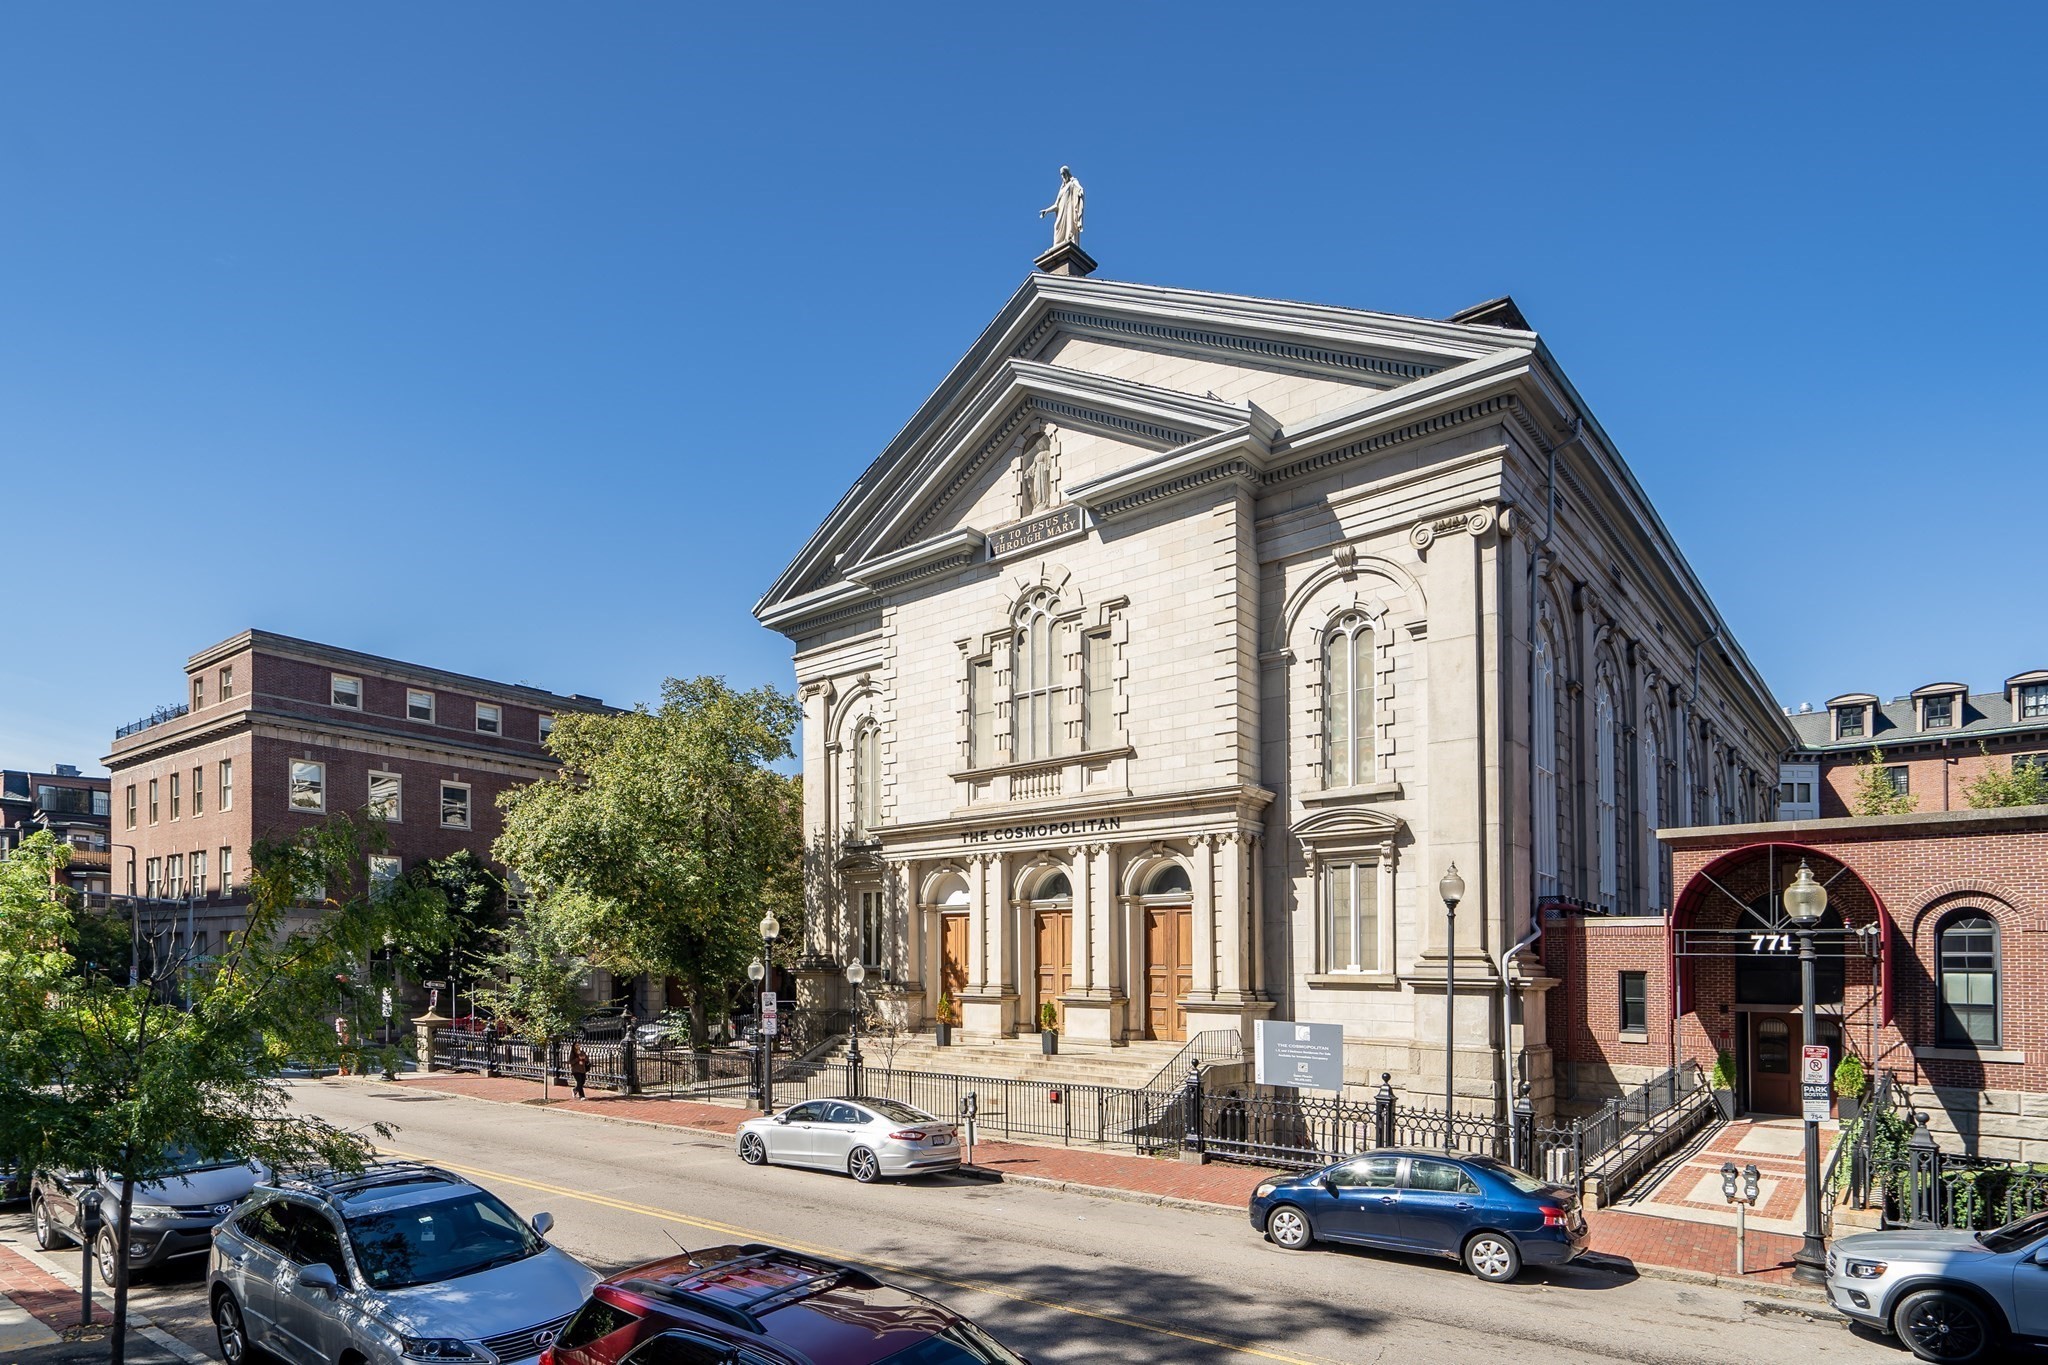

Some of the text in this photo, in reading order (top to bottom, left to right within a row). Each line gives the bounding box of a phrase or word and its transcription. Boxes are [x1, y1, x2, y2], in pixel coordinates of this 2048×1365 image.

[993, 520, 1077, 554] THROUGH MARY
[1009, 517, 1059, 540] TO JESUS
[961, 817, 1121, 843] THE COSMOPOLITAN
[1751, 935, 1792, 950] 771
[1803, 1085, 1827, 1093] PARK
